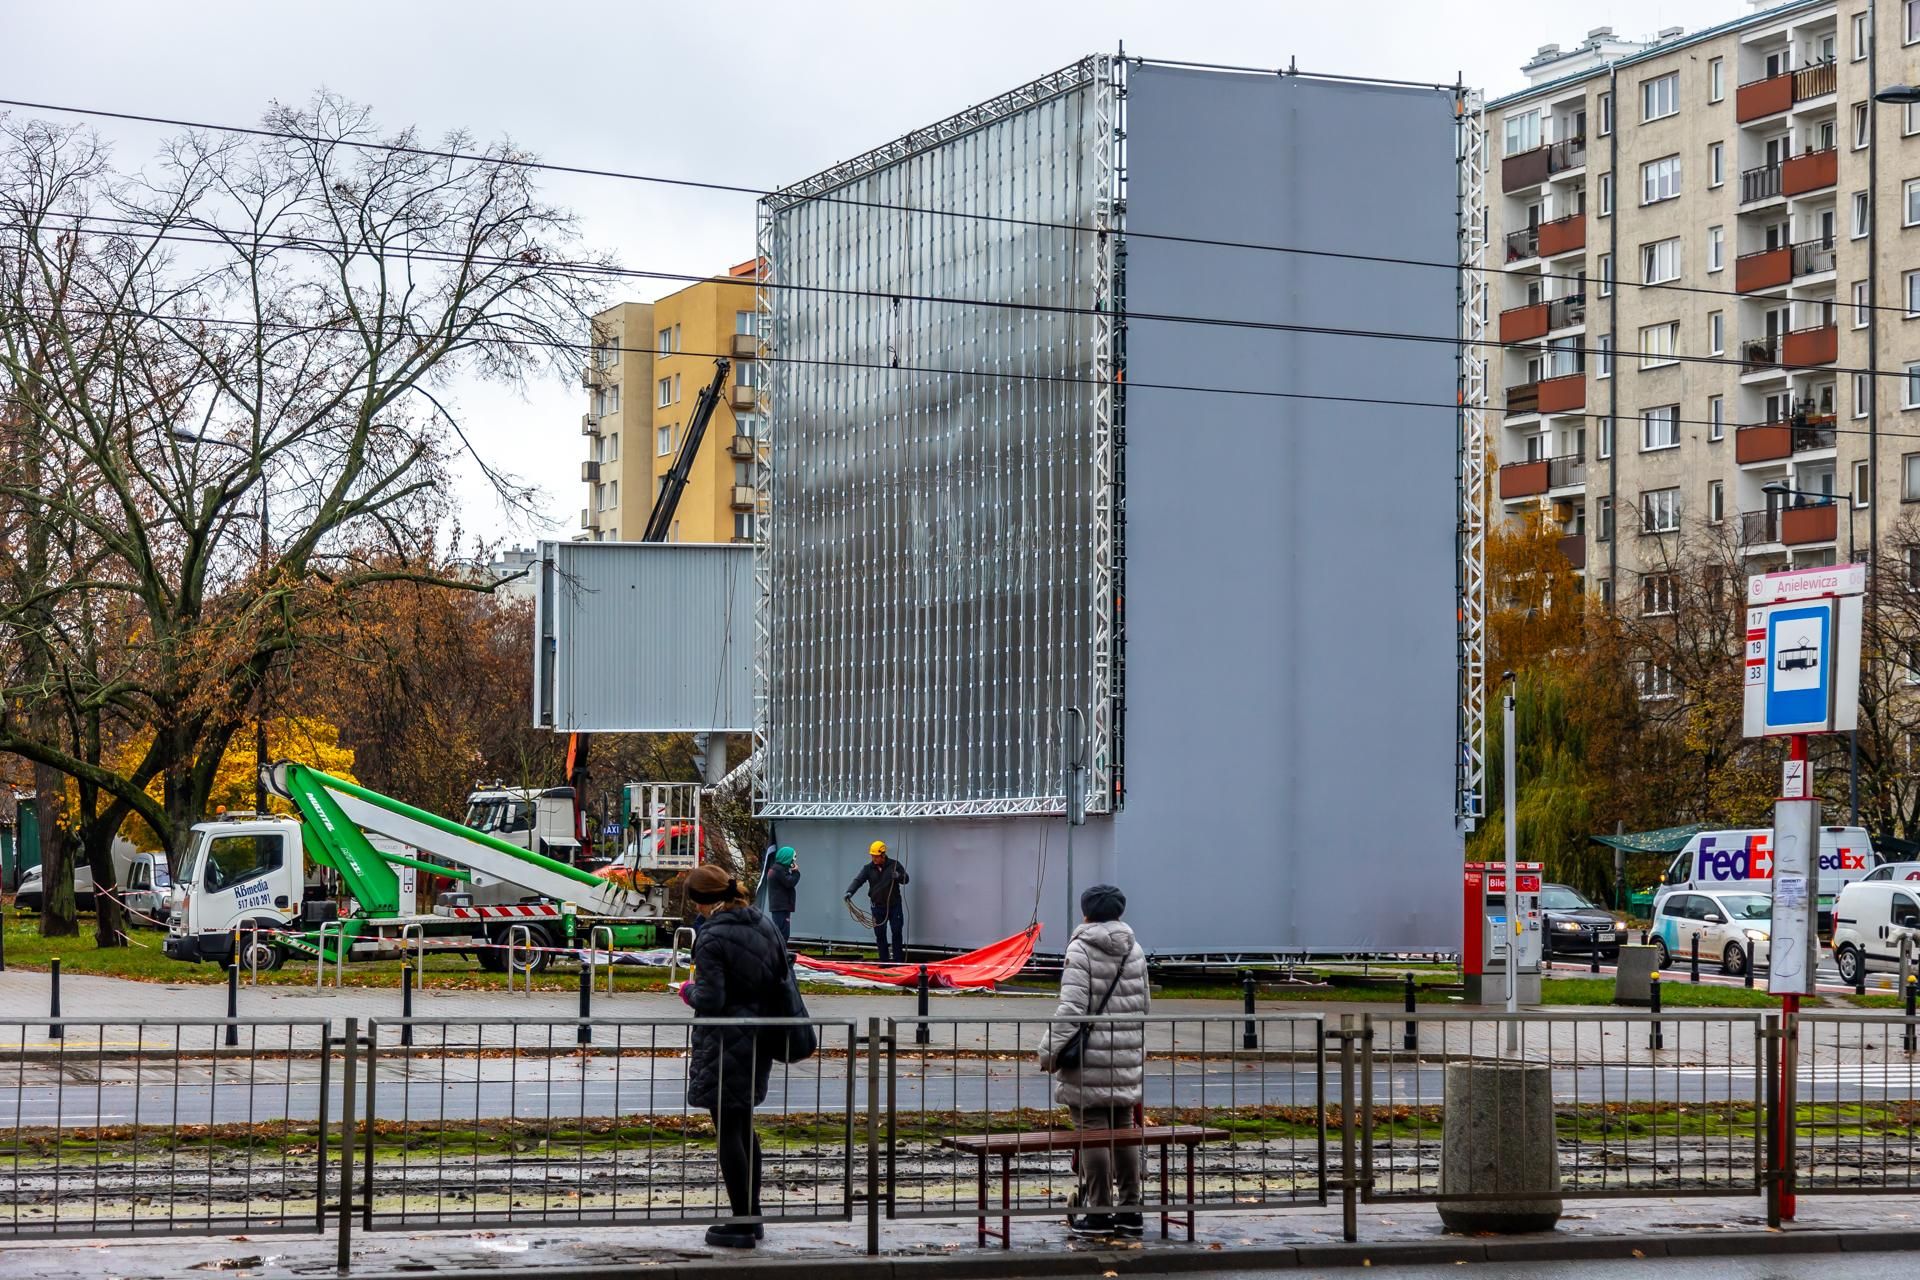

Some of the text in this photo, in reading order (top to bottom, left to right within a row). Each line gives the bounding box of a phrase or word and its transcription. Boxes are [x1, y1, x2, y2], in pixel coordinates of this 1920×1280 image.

[1777, 576, 1838, 593] Anielewicza
[1751, 612, 1763, 625] 17
[1751, 641, 1762, 654] 19
[1750, 666, 1762, 680] 33
[1698, 835, 1774, 881] FedE
[1819, 848, 1866, 870] edEx
[234, 879, 269, 898] RBmedia
[1490, 878, 1505, 887] Bile
[238, 893, 271, 909] 517 610 291
[567, 924, 574, 933] 2
